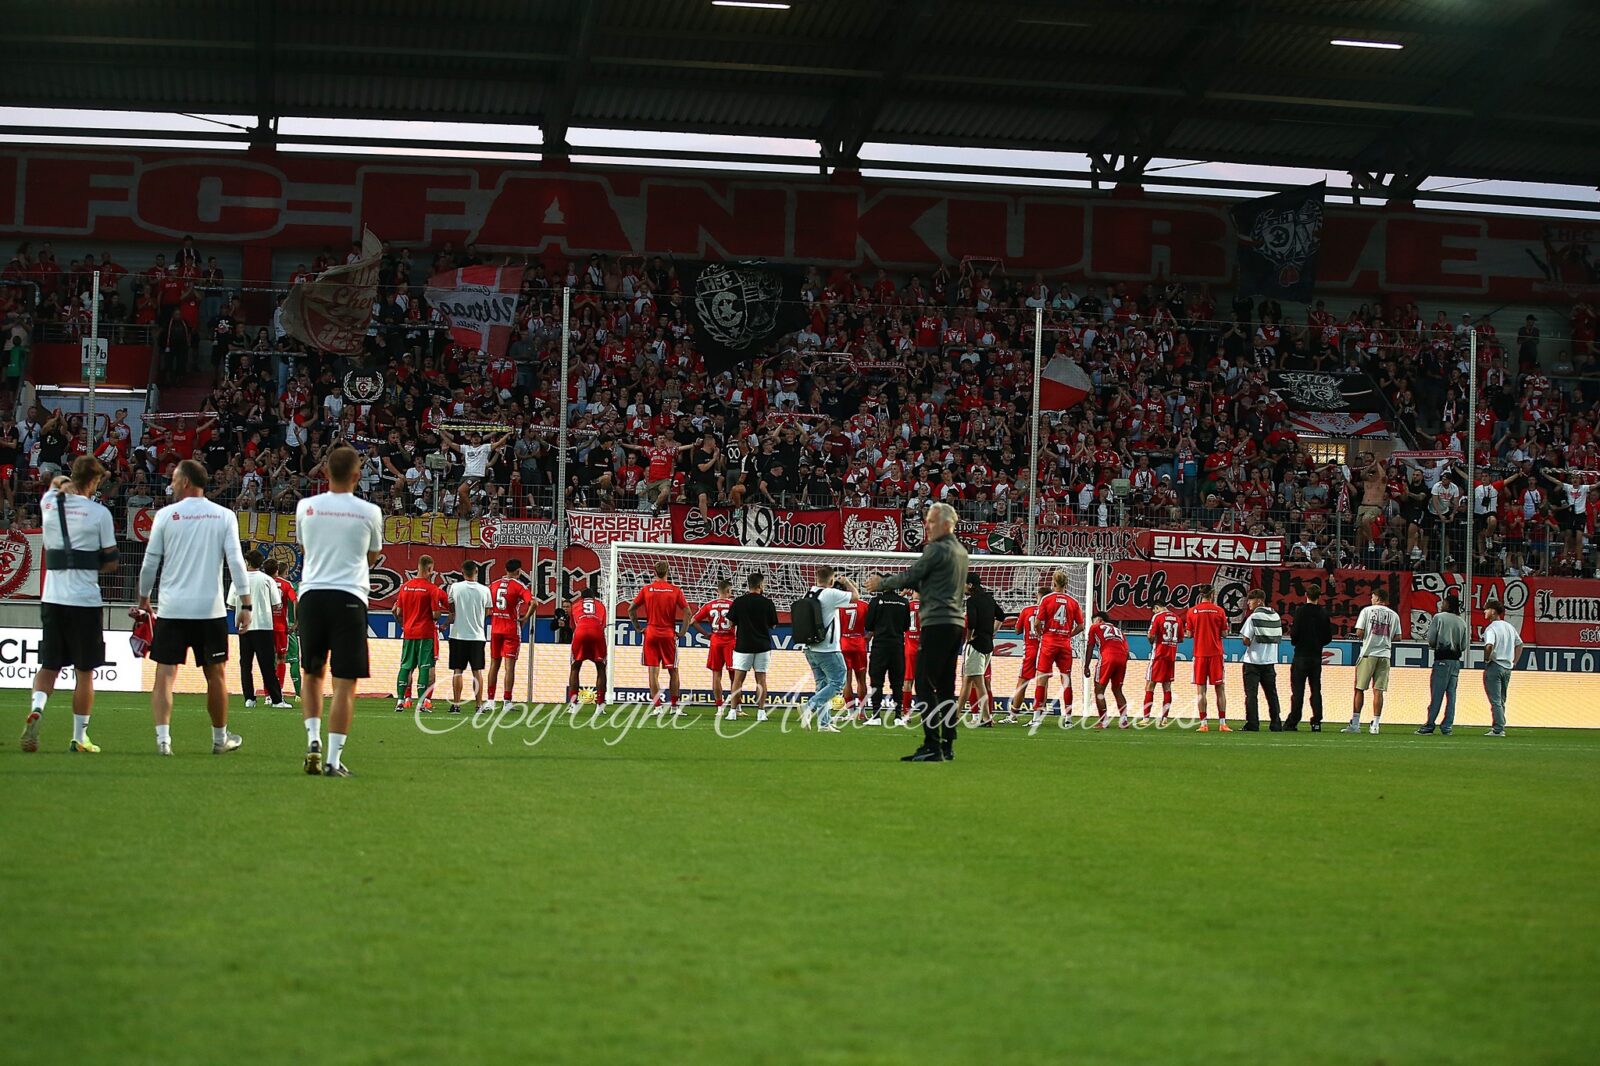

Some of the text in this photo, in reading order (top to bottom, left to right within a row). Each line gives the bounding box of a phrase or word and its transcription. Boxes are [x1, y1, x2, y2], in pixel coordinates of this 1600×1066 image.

[1153, 535, 1282, 562] SURREALE
[496, 588, 507, 611] 5
[583, 602, 595, 614] 9
[846, 609, 858, 631] 7
[1053, 605, 1068, 625] 4
[1163, 621, 1179, 642] 31
